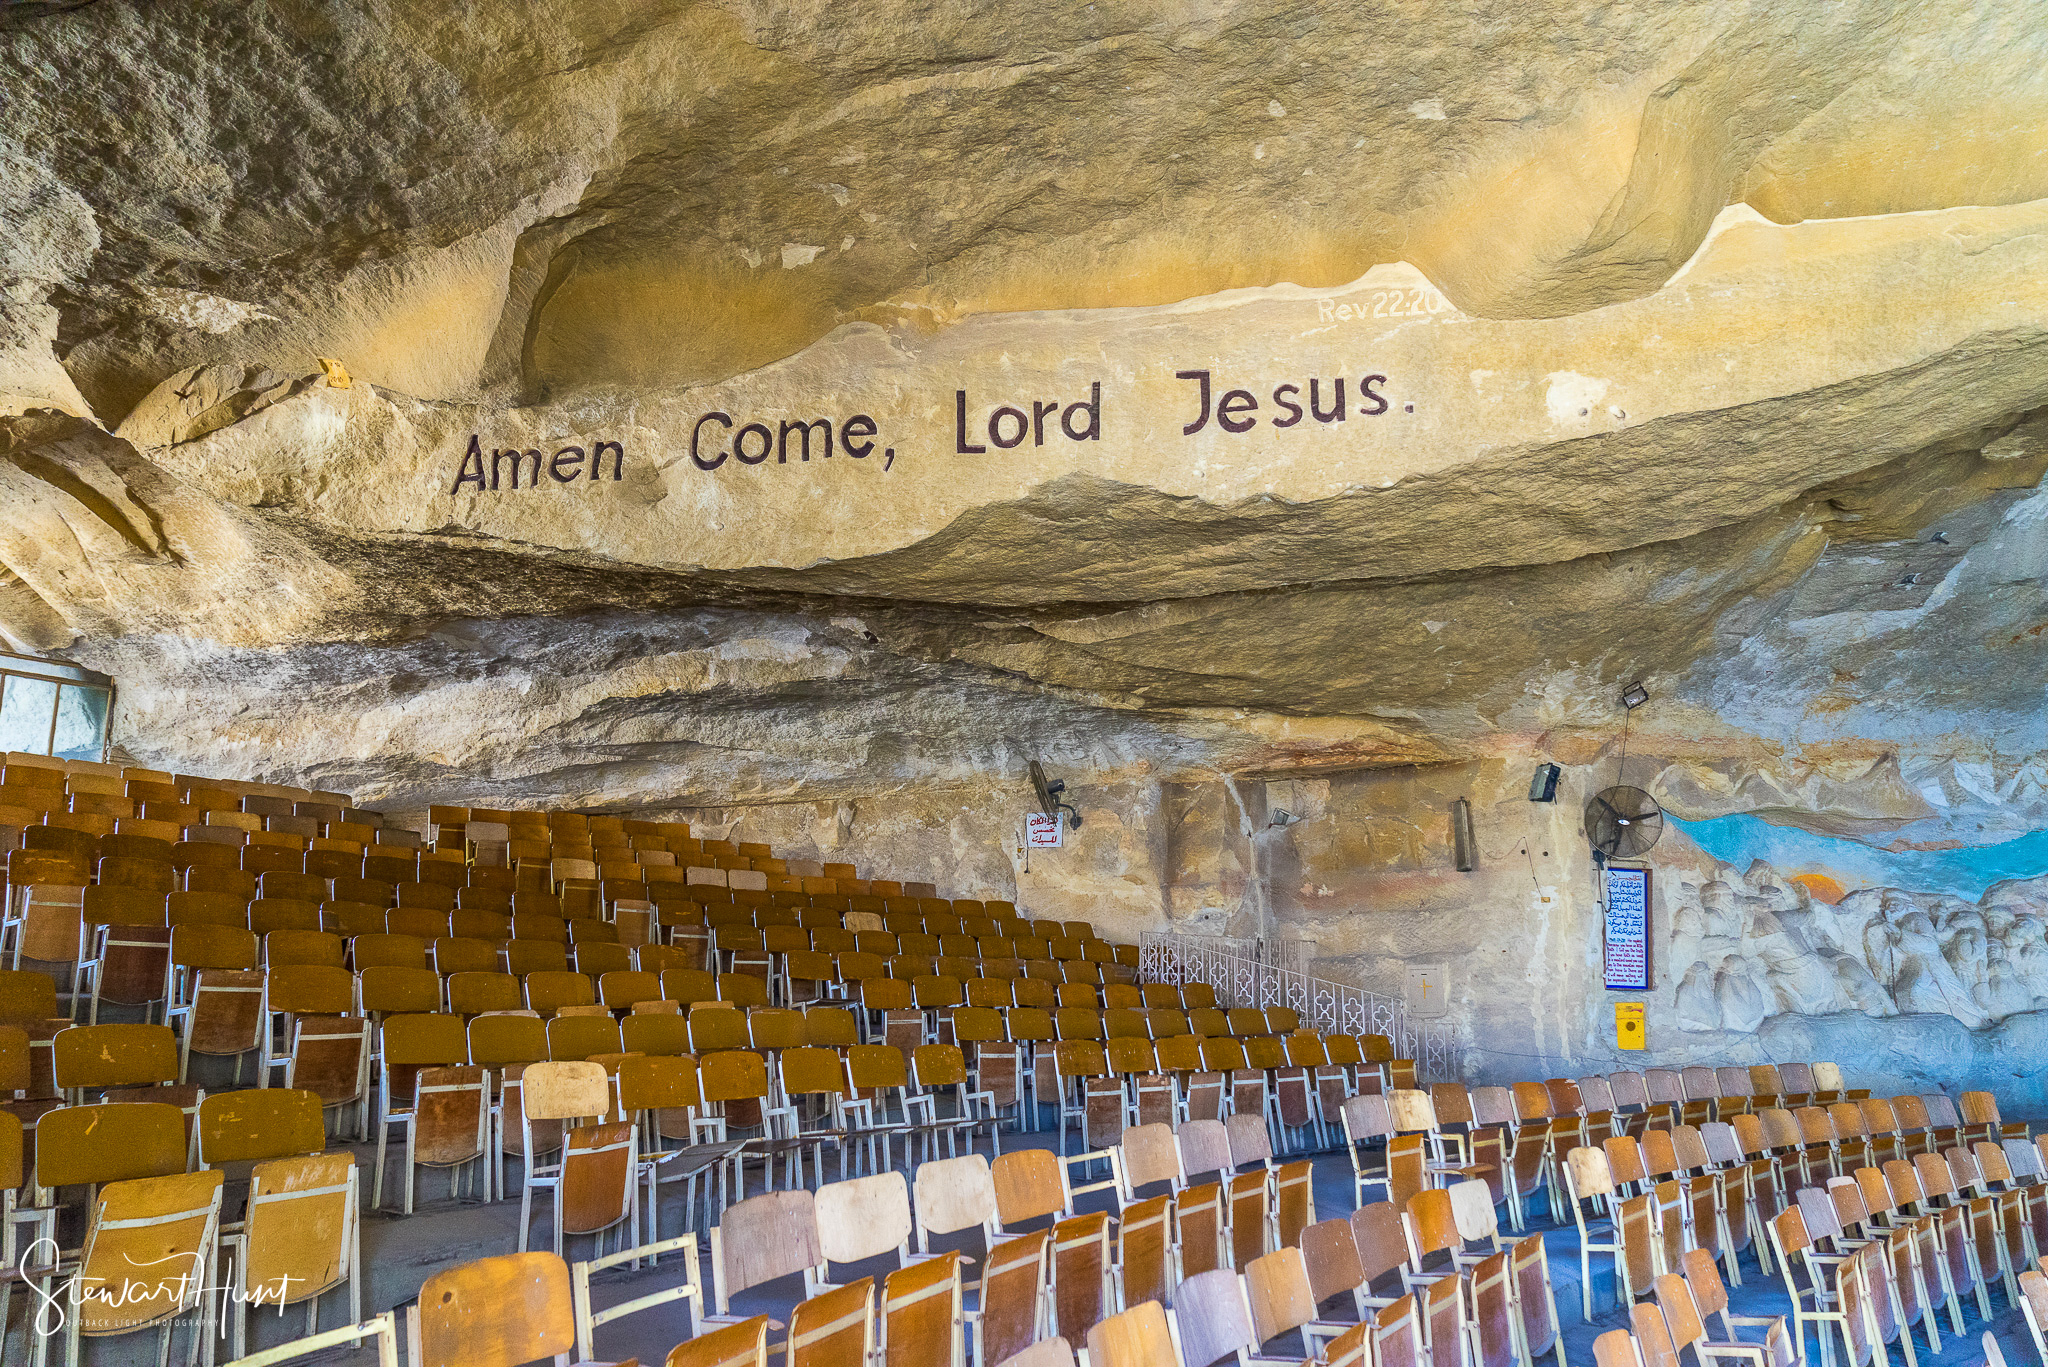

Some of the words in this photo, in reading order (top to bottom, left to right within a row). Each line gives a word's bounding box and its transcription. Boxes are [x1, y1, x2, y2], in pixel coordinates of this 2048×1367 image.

[450, 434, 624, 496] Amen
[690, 411, 896, 474] Come,
[955, 381, 1102, 455] Lord
[1174, 371, 1415, 438] Jesus.
